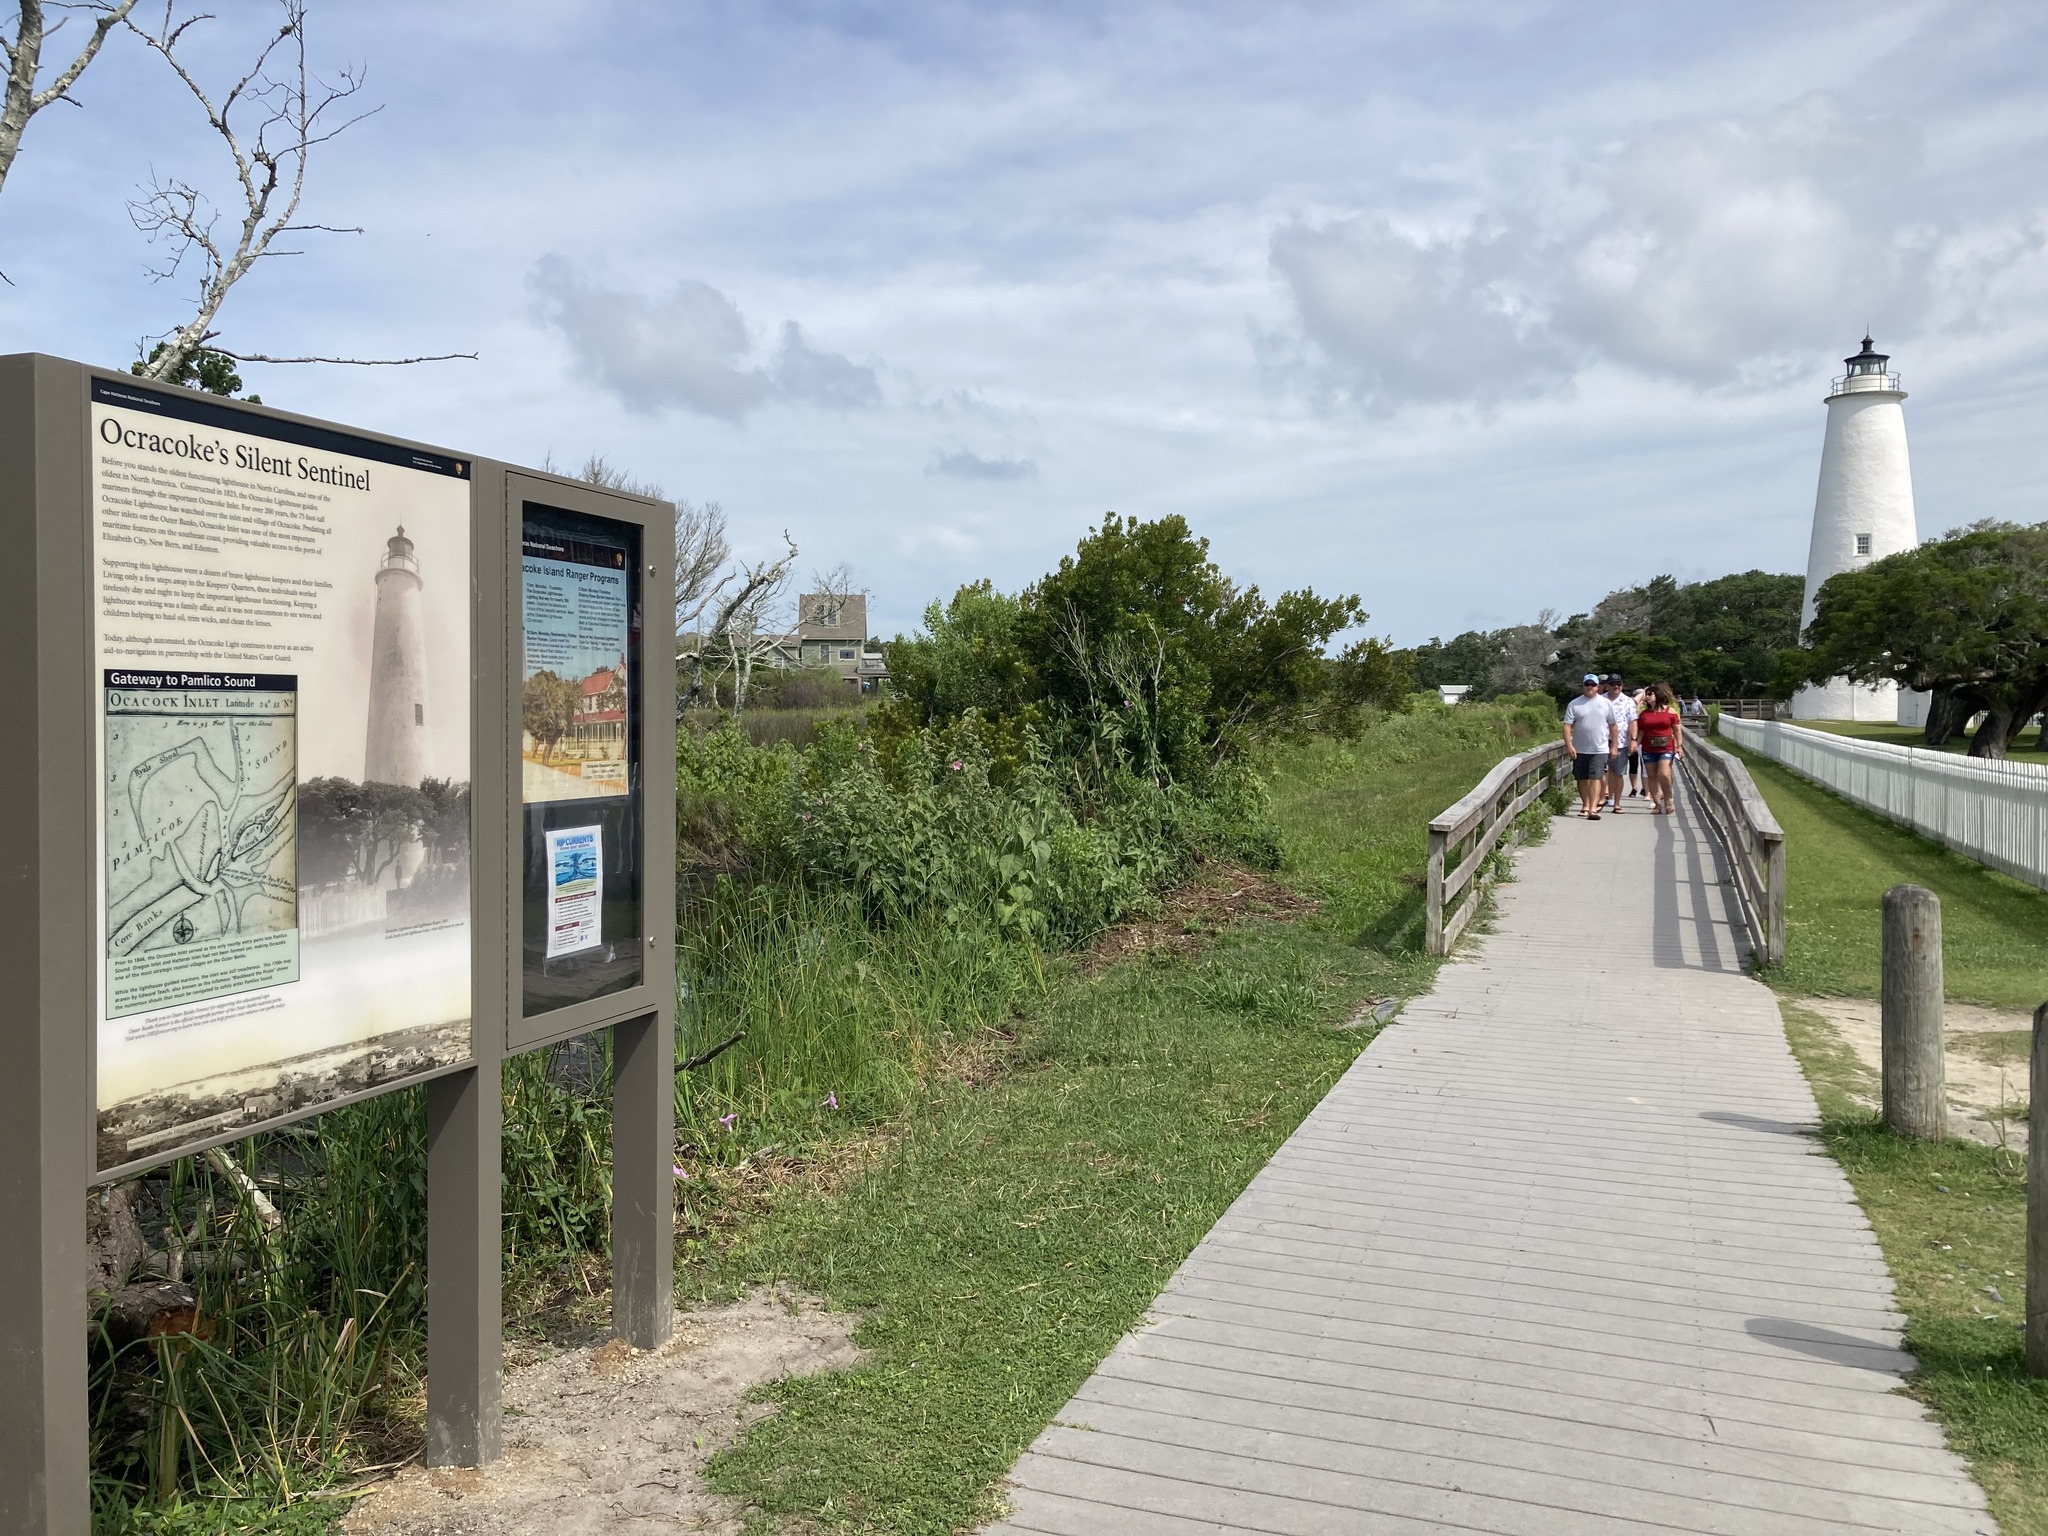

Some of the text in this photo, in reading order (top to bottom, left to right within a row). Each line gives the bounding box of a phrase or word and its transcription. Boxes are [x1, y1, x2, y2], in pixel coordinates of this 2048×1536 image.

[100, 418, 370, 491] Ocracoke's Silent Sentinel
[101, 456, 123, 467] Before
[137, 464, 157, 473] stands
[102, 470, 121, 479] oldest
[130, 474, 150, 483] North
[102, 484, 131, 493] mariners
[131, 486, 157, 498] through
[102, 494, 133, 506] Ocracoke
[134, 499, 168, 511] Lighthouse
[102, 508, 120, 516] other
[121, 510, 138, 519] inlets
[102, 521, 131, 530] maritime
[132, 523, 157, 534] features
[102, 532, 132, 543] Elizabeth
[133, 536, 148, 546] City,
[102, 558, 139, 570] Supporting
[139, 562, 151, 570] this
[103, 570, 124, 581] Living
[124, 573, 138, 583] only
[543, 565, 564, 577] Island
[566, 569, 589, 582] Ranger
[590, 572, 619, 584] Programs
[103, 584, 131, 594] tirelessly
[132, 586, 143, 595] day
[103, 596, 136, 605] lighthouse
[137, 599, 163, 609] working
[103, 608, 130, 617] children
[131, 610, 154, 621] helping
[103, 633, 124, 643] Today,
[125, 635, 153, 645] although
[103, 647, 157, 657] aid-to-navigation
[111, 672, 256, 688] Gateway to Pamlico Sound
[256, 740, 287, 769] SOUND
[566, 834, 593, 845] CURRENTS
